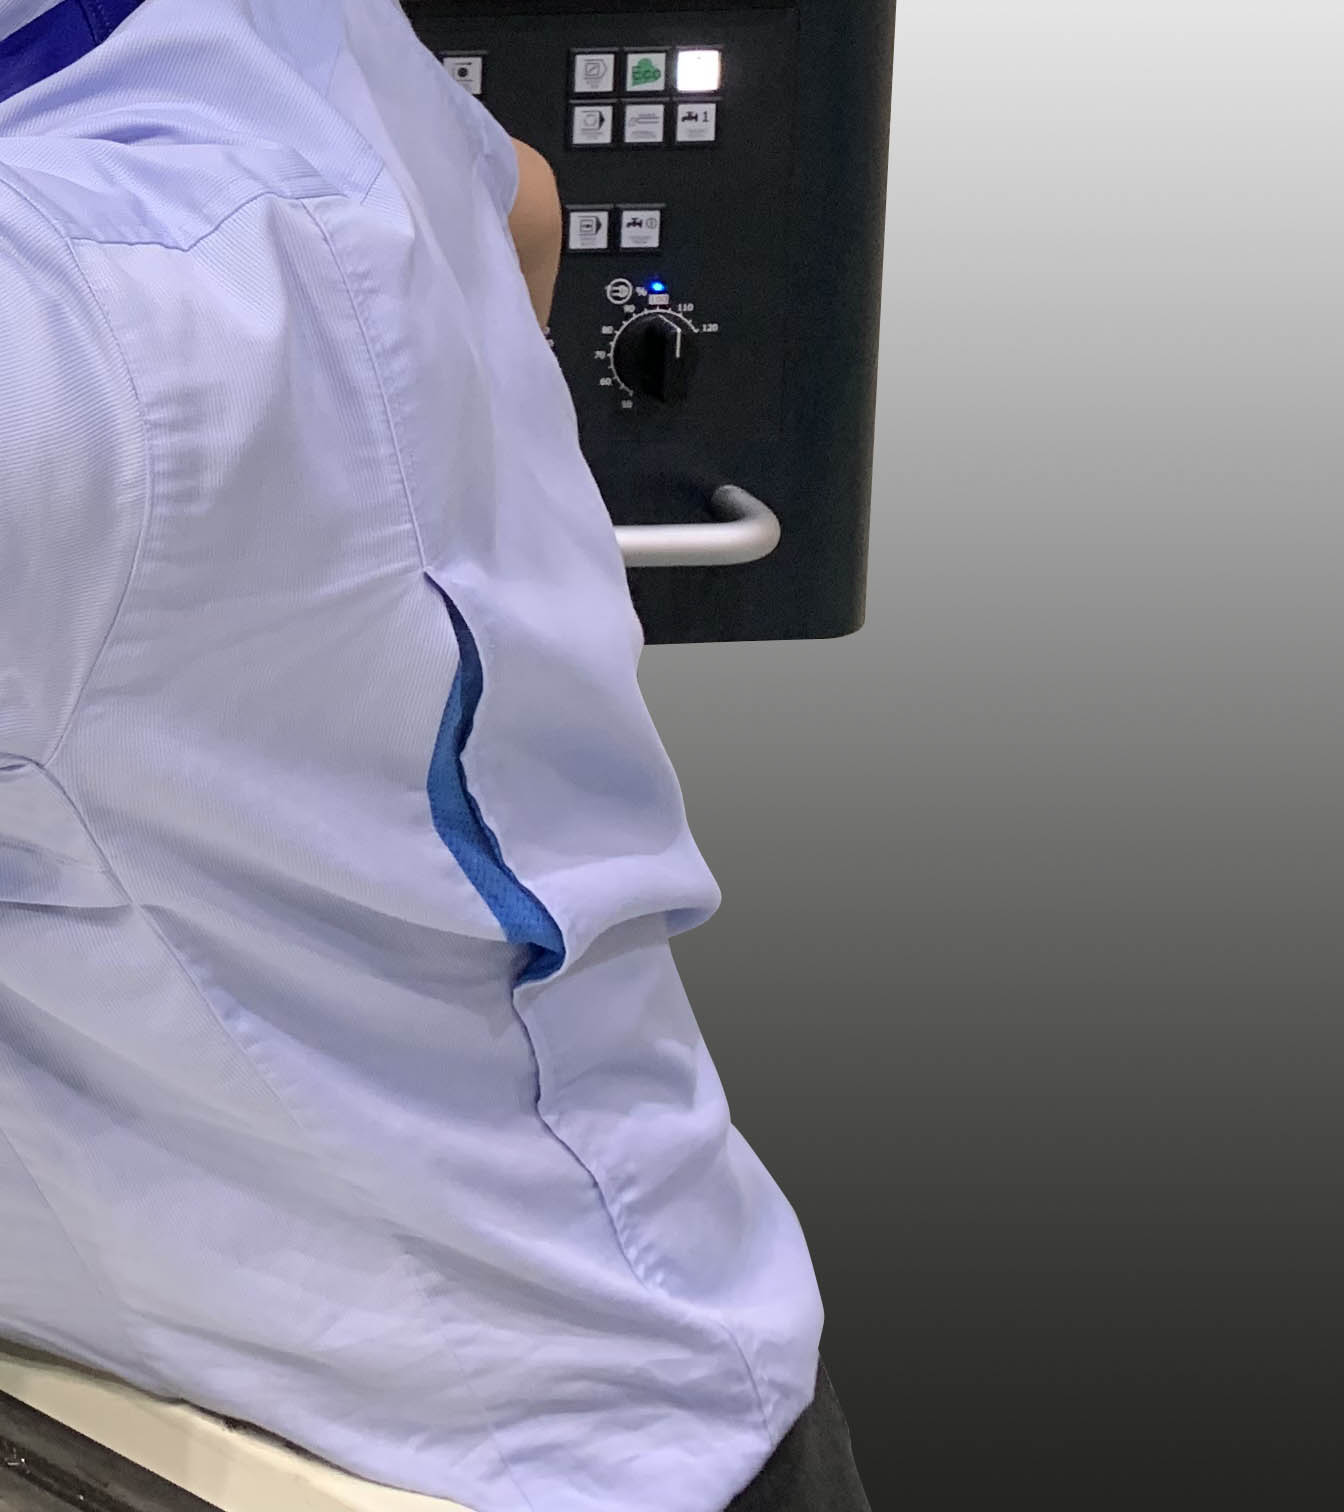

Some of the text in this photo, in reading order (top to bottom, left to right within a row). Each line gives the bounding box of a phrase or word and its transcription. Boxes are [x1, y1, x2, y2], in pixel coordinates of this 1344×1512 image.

[677, 303, 694, 311] 110
[702, 323, 719, 332] 120
[594, 350, 607, 359] 70
[600, 377, 612, 386] 60
